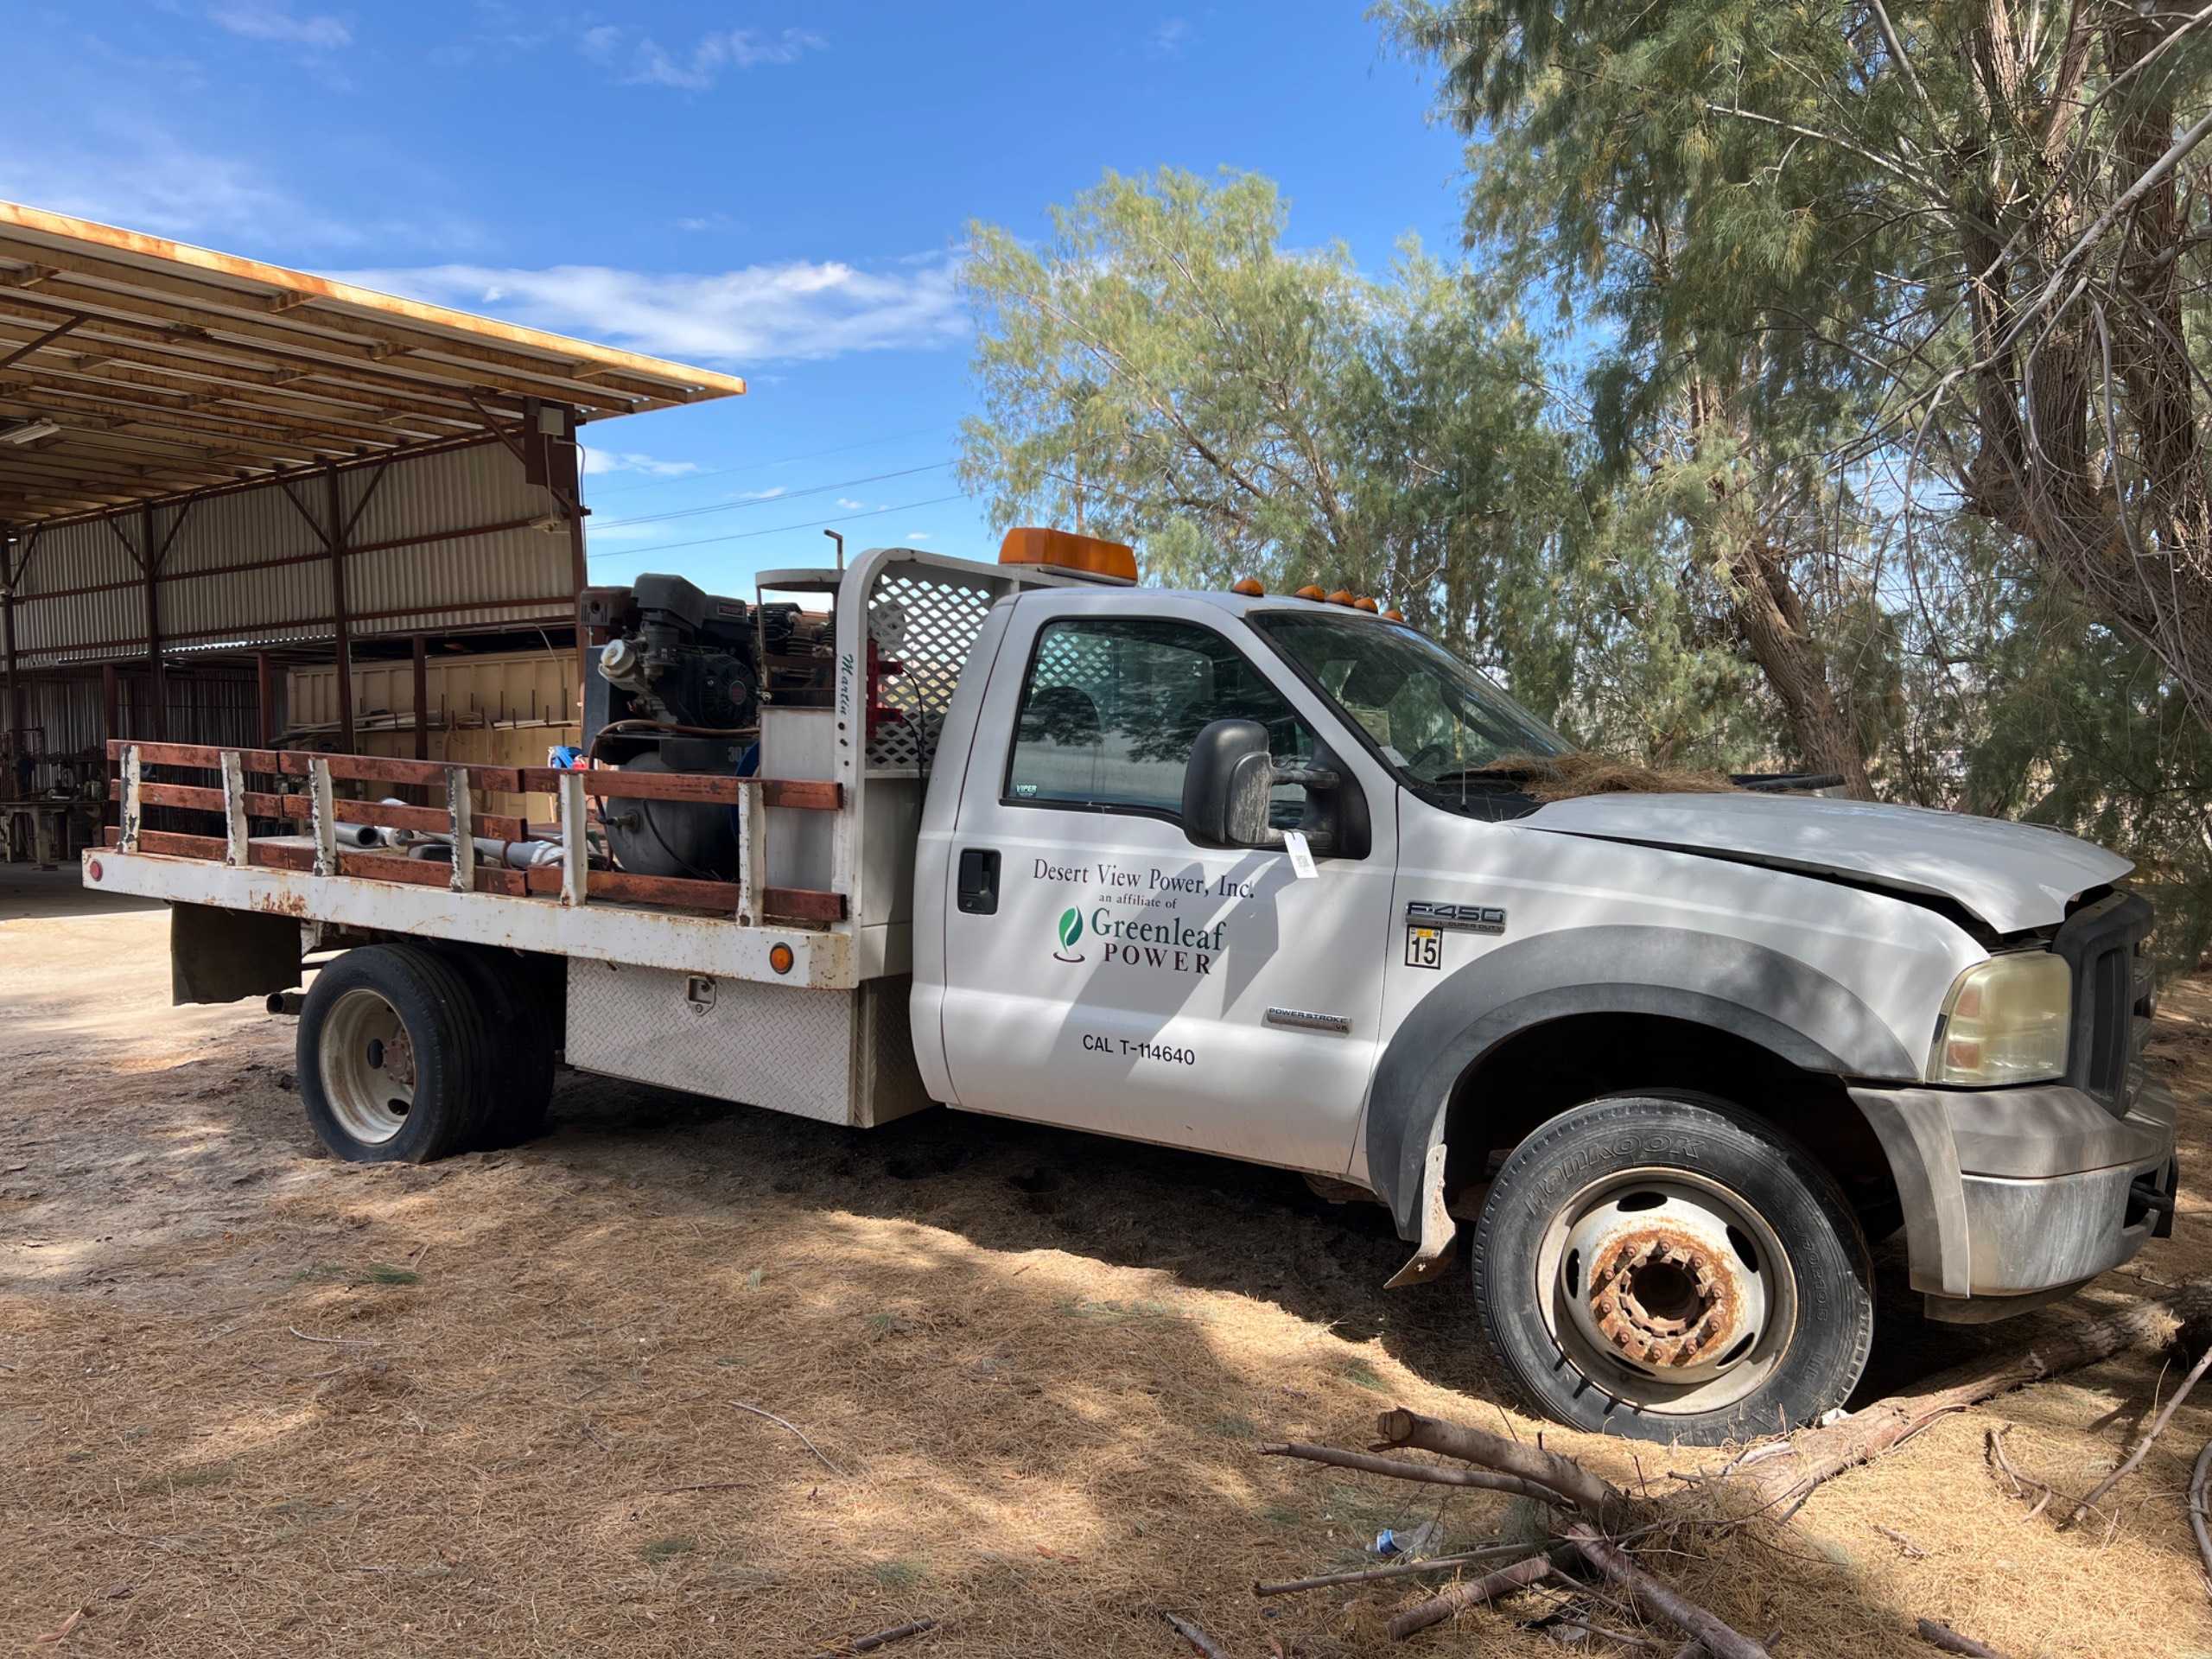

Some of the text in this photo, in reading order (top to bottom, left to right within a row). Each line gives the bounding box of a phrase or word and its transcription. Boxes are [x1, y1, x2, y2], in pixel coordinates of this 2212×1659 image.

[1016, 784, 1037, 793] VIPER
[1033, 858, 1255, 899] Desert View Power, Inc.
[1098, 893, 1179, 909] an affiliate of
[1407, 902, 1506, 923] F-450
[1090, 907, 1228, 950] Greenleaf
[1103, 943, 1211, 976] POWER
[1412, 937, 1437, 964] 15
[1083, 1034, 1195, 1065] CAL T-114640
